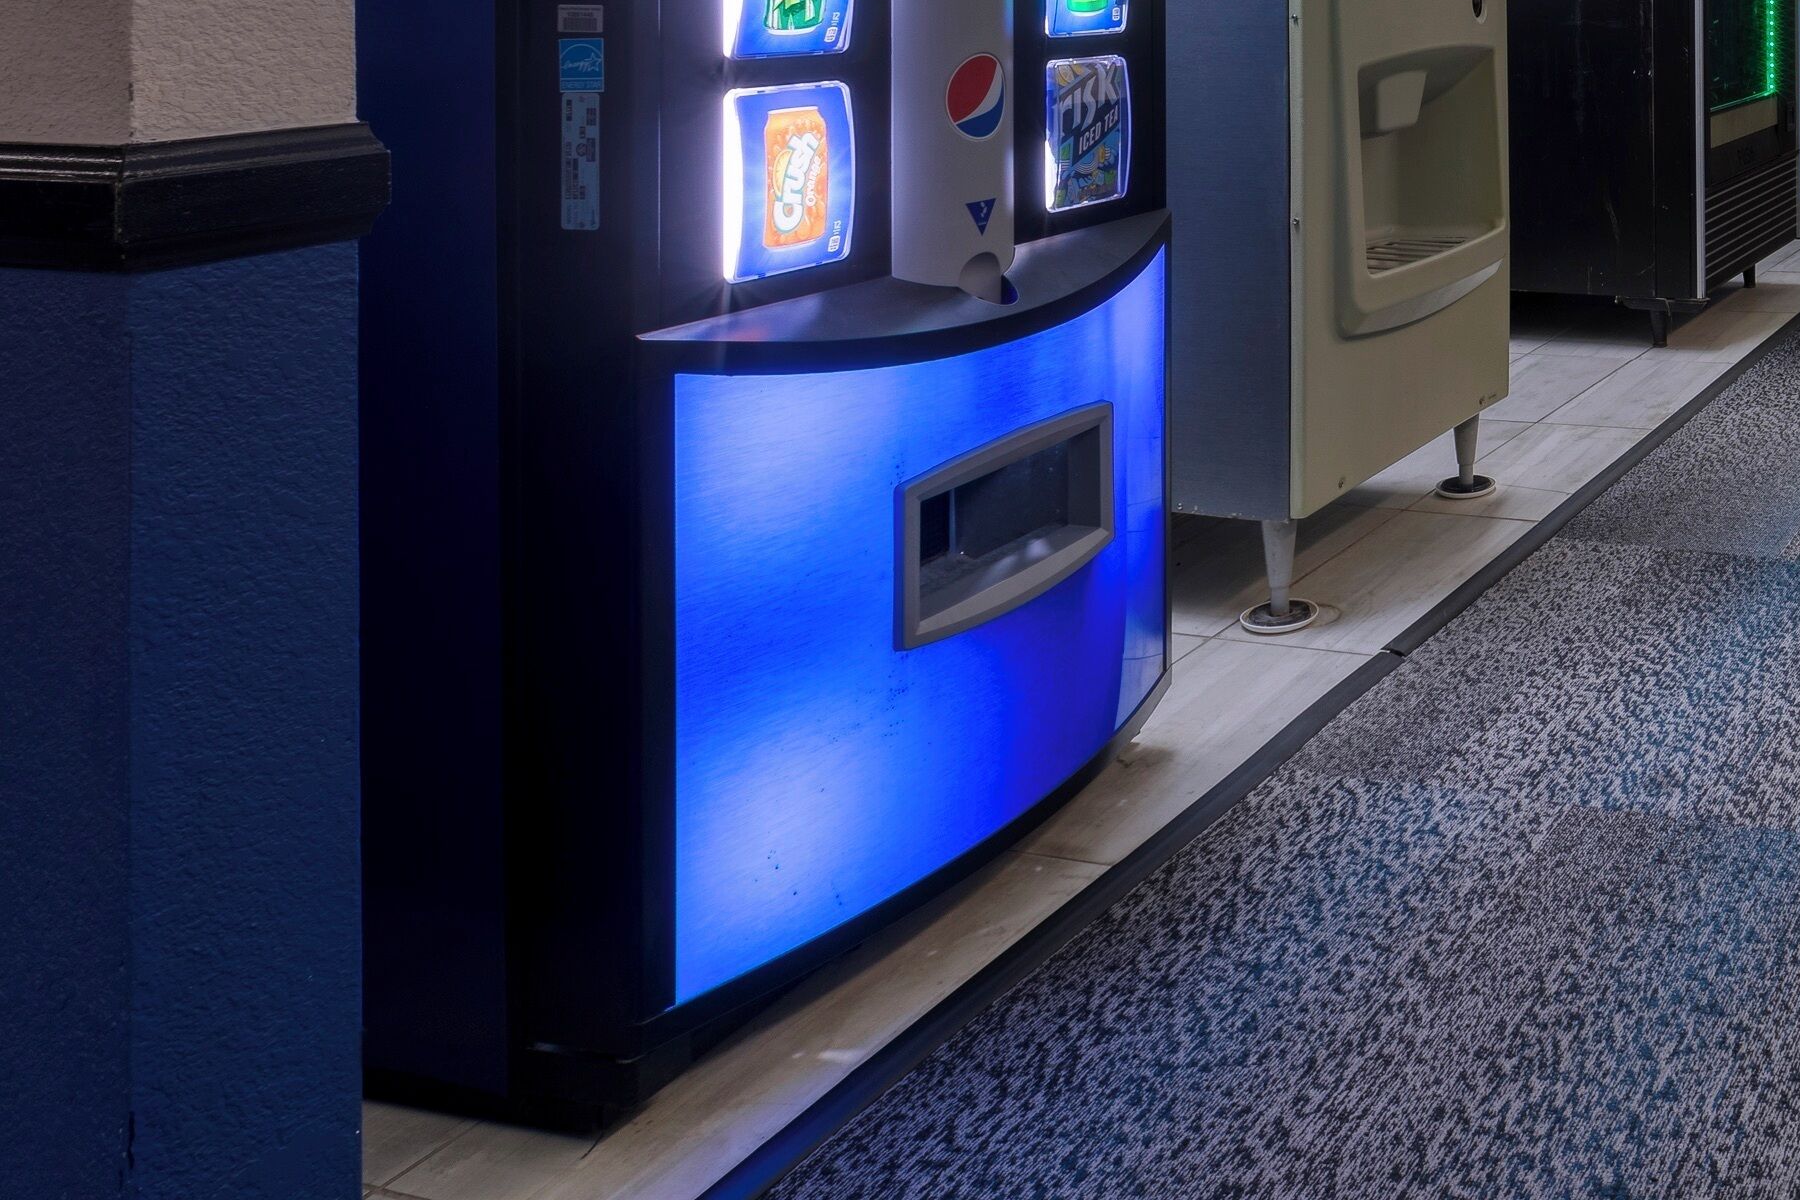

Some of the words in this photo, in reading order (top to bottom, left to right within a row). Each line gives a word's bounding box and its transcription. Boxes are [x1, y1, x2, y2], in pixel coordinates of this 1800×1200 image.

[1079, 122, 1102, 155] ICED
[1104, 105, 1119, 134] TEA
[773, 132, 820, 234] Crush
[805, 155, 822, 207] Orange
